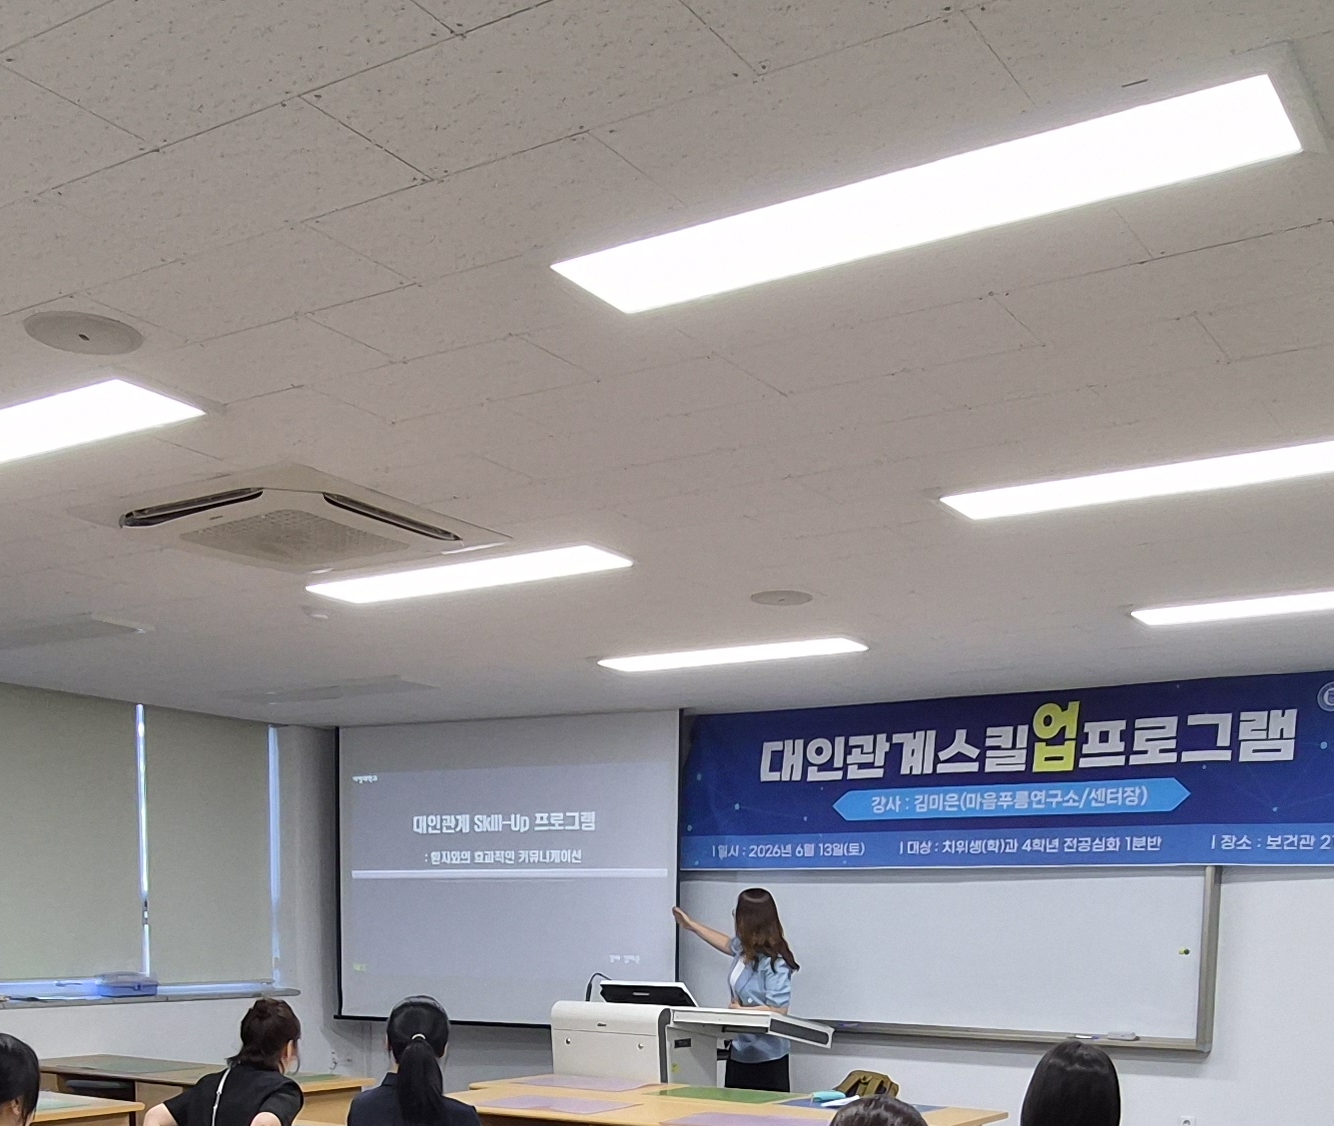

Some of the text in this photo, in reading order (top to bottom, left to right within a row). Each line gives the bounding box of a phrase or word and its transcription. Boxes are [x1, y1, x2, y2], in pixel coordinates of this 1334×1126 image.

[871, 796, 901, 813] 강사
[413, 814, 470, 834] 대인관계
[534, 811, 596, 831] 프로그램
[718, 845, 739, 858] 일시
[748, 844, 793, 858] 2026년
[795, 843, 815, 857] 6월
[818, 842, 866, 857] 13일(토)
[907, 840, 932, 855] 대상
[942, 838, 1018, 855] 치위생(학)과
[1021, 837, 1060, 853] 4학년
[1063, 836, 1120, 852] 전공심화
[1125, 835, 1162, 852] 1분반
[1220, 835, 1252, 850] 장소
[1266, 834, 1316, 850] 보건관
